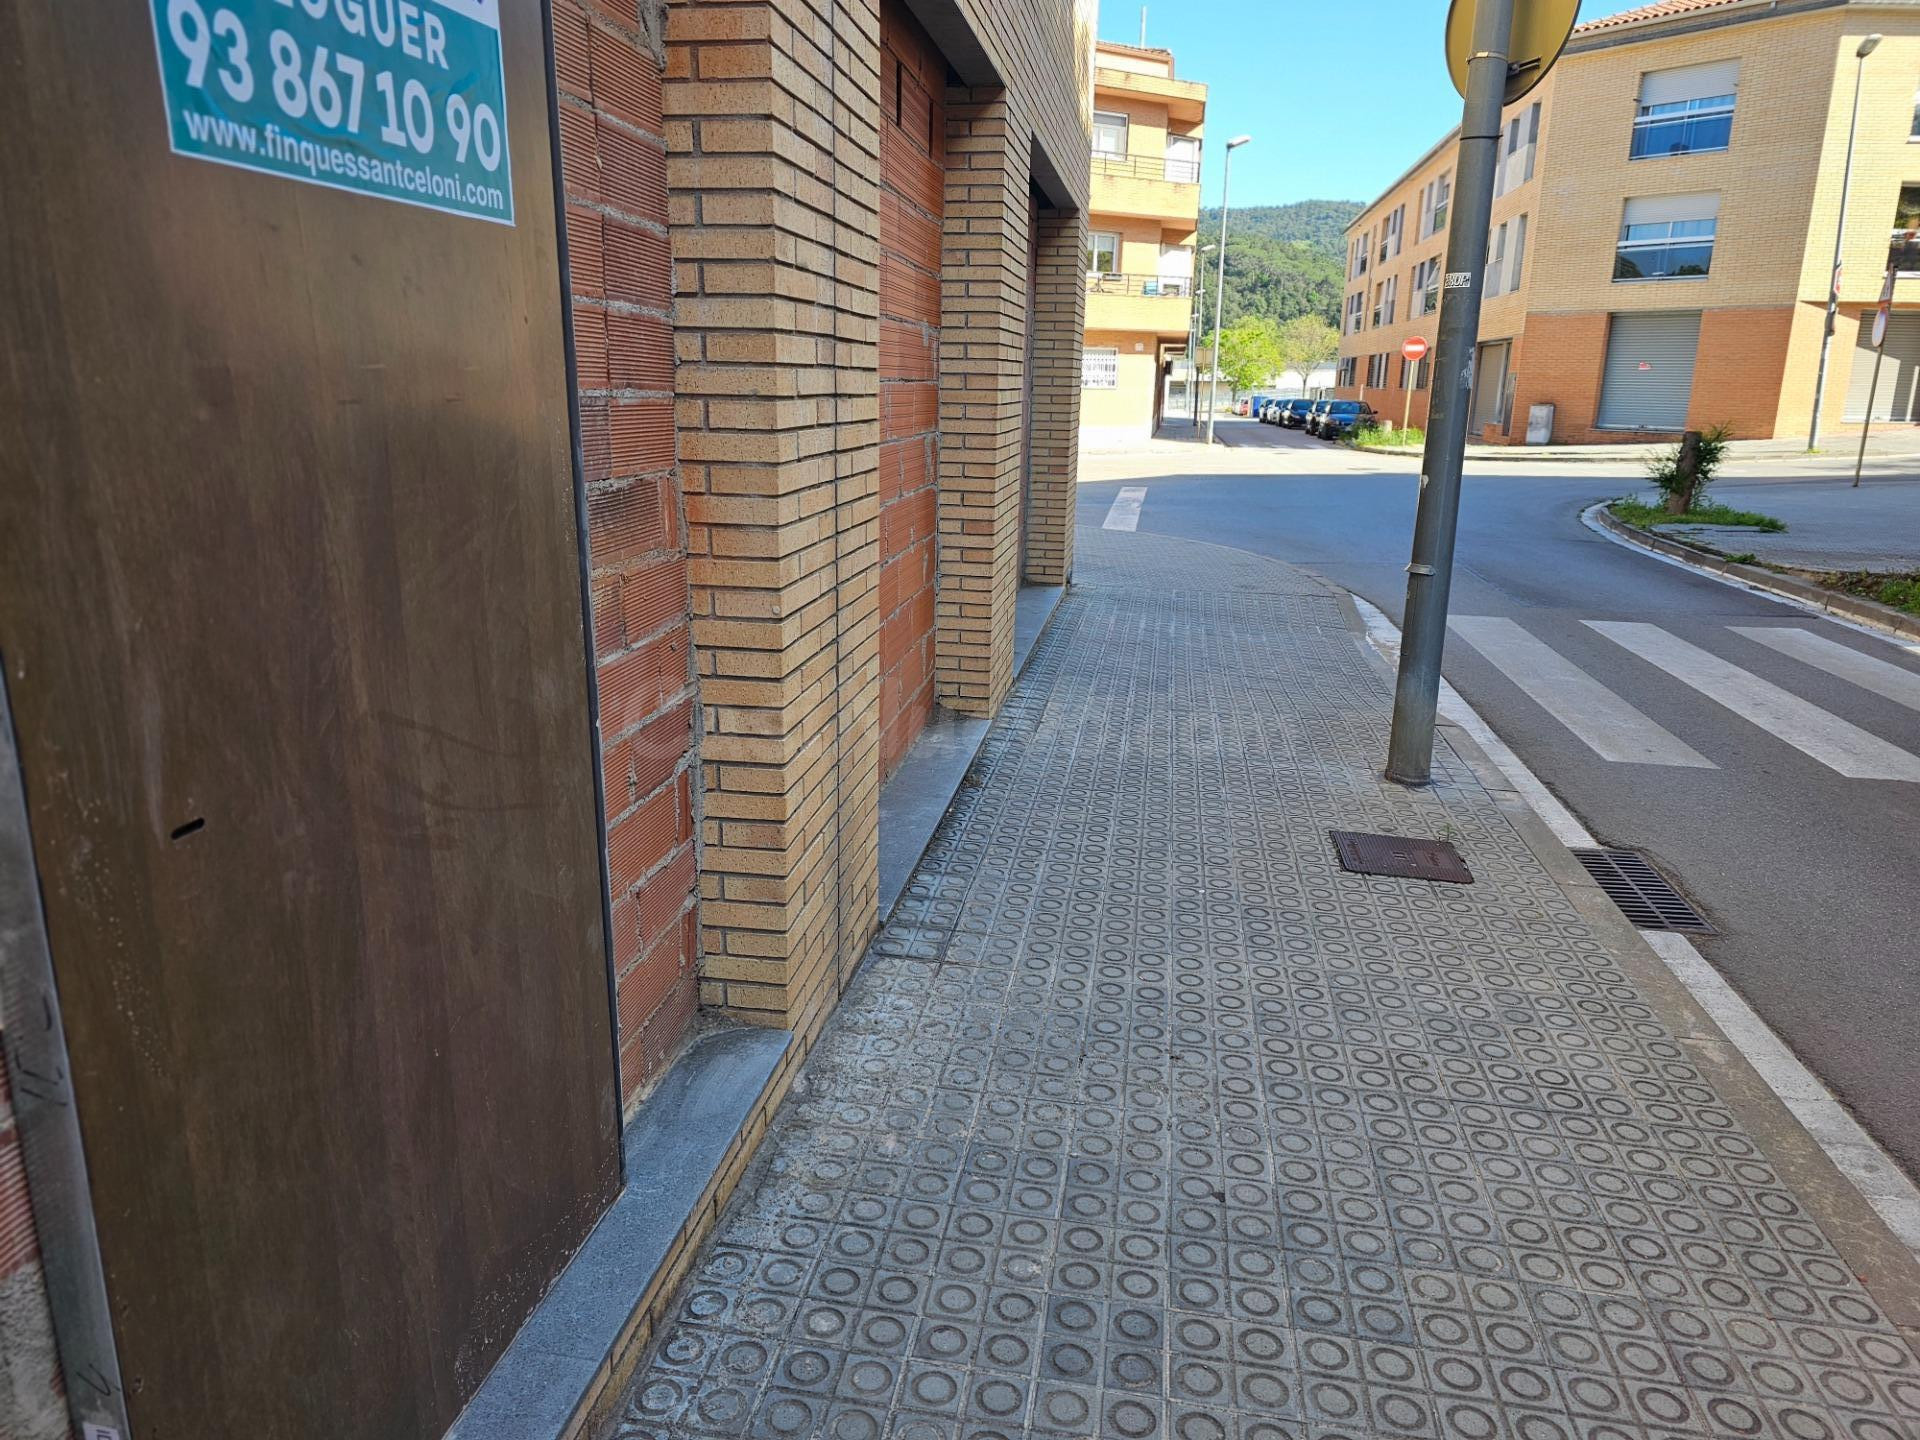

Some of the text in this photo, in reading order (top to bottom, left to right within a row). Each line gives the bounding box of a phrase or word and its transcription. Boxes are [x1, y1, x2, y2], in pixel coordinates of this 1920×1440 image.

[274, 0, 448, 69] GUER
[168, 0, 501, 171] 93 867 10 90
[184, 111, 504, 209] www.finquessantceloni.com
